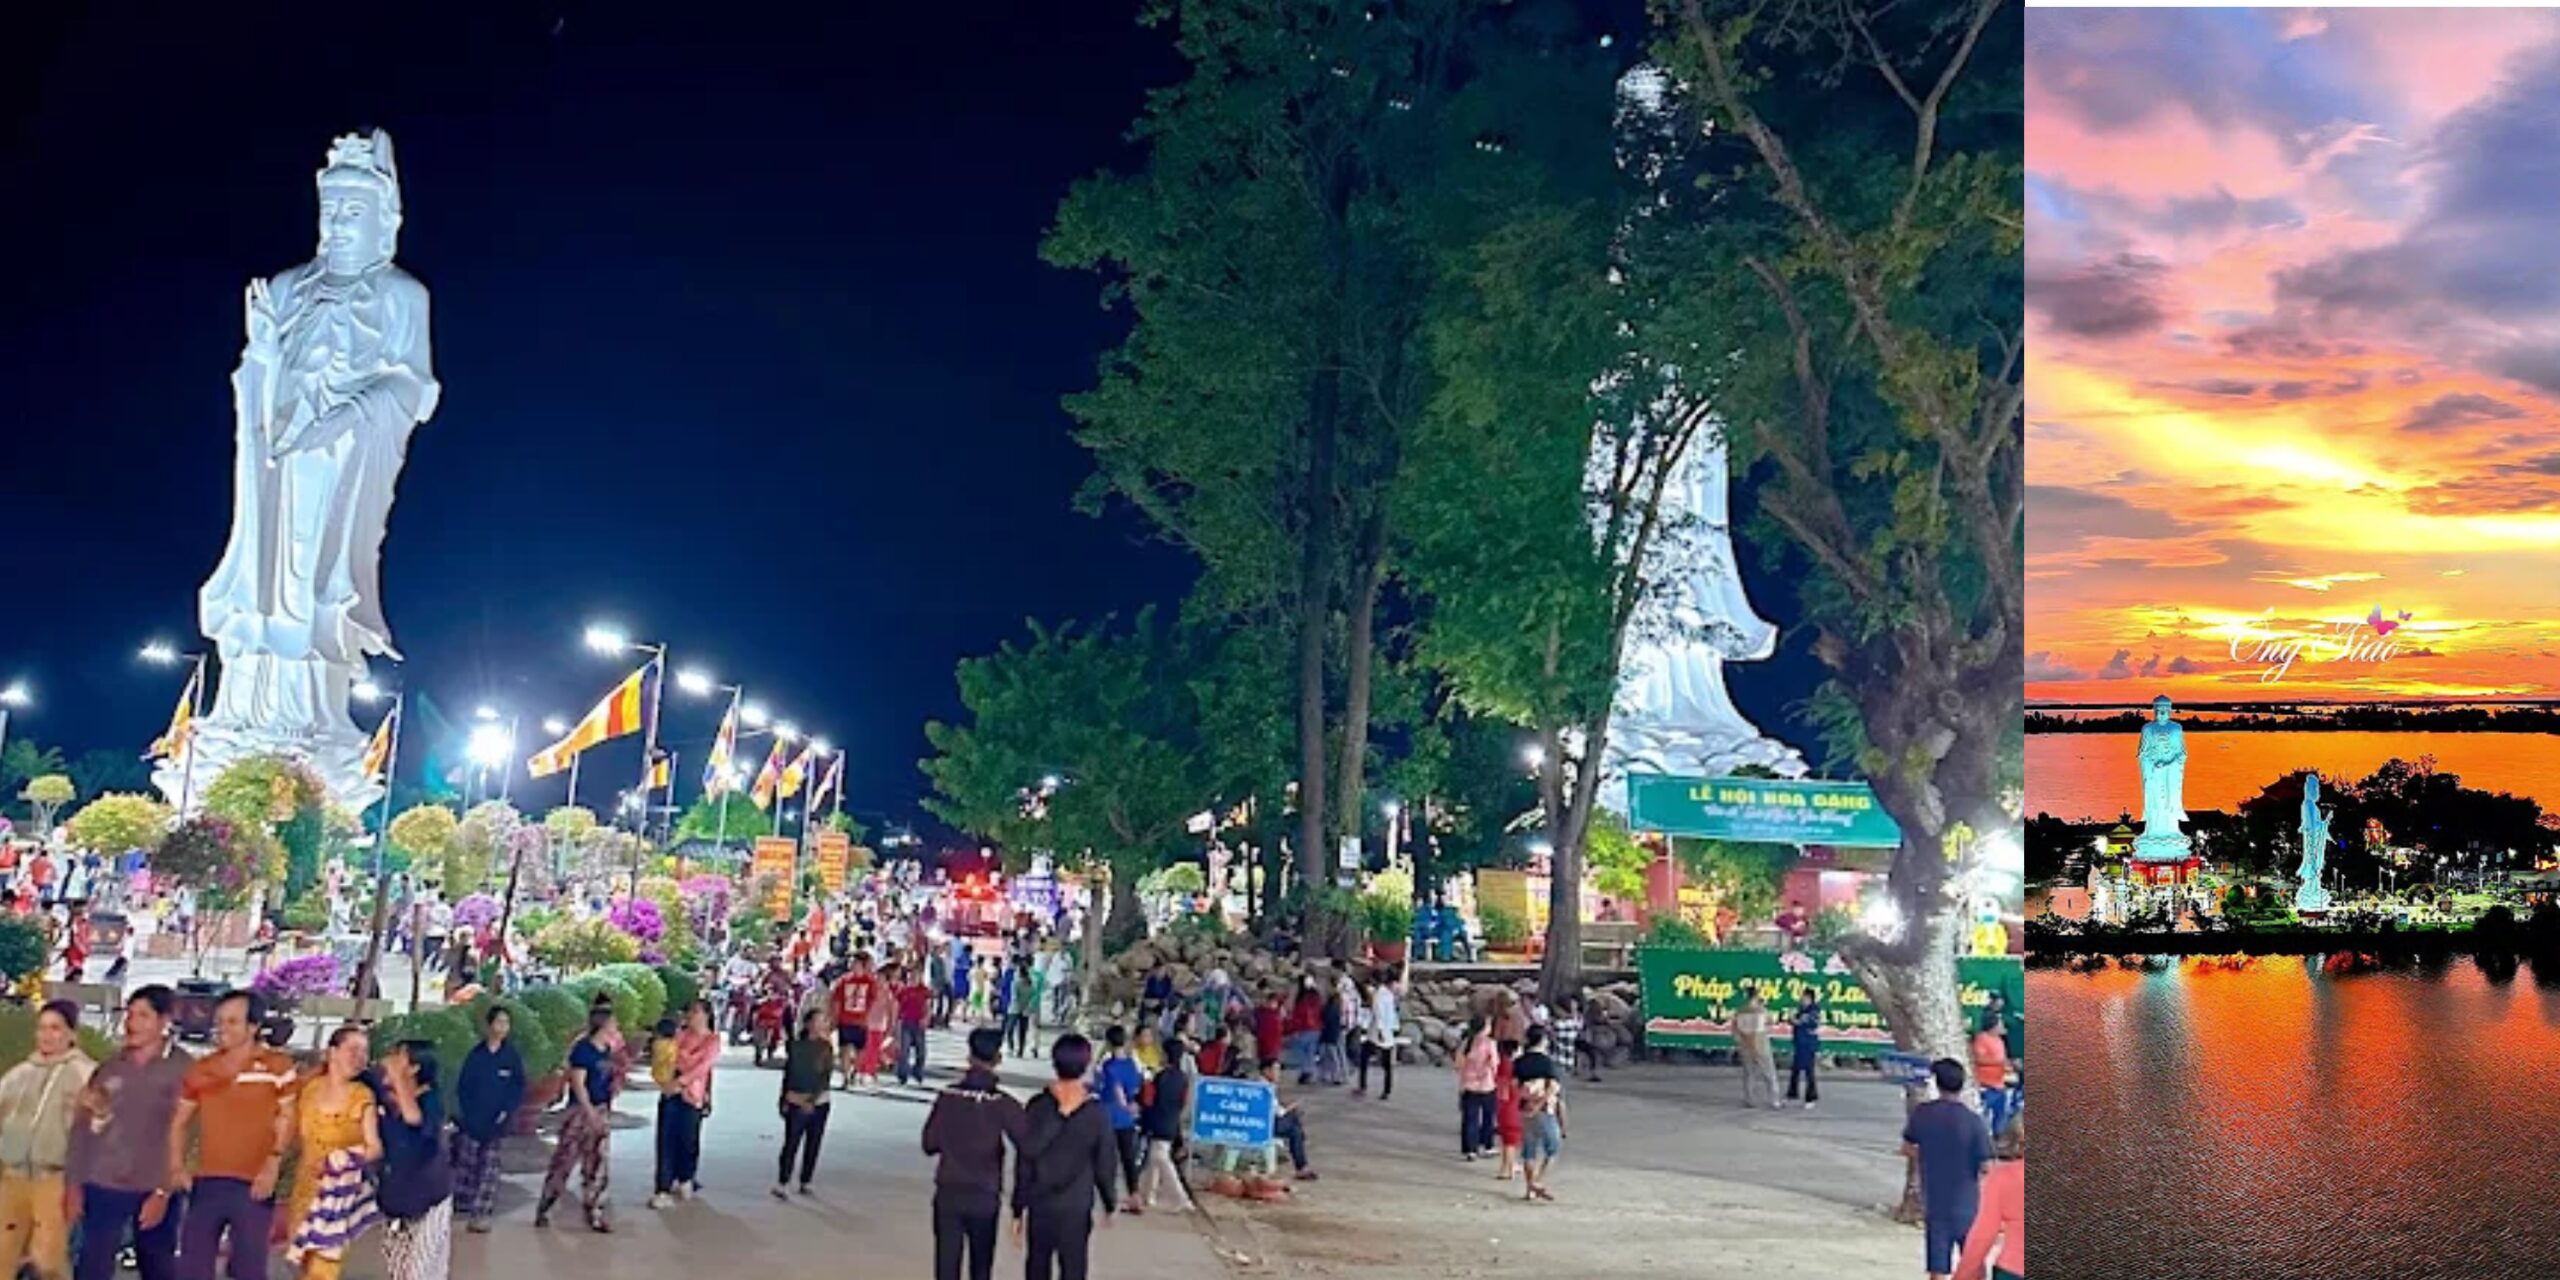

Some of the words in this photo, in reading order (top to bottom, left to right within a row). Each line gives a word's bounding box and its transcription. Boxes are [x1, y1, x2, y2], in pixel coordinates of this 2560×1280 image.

[1719, 786, 1756, 804] HỘI
[1763, 789, 1806, 807] HOA
[1674, 974, 1735, 1006] Pháp
